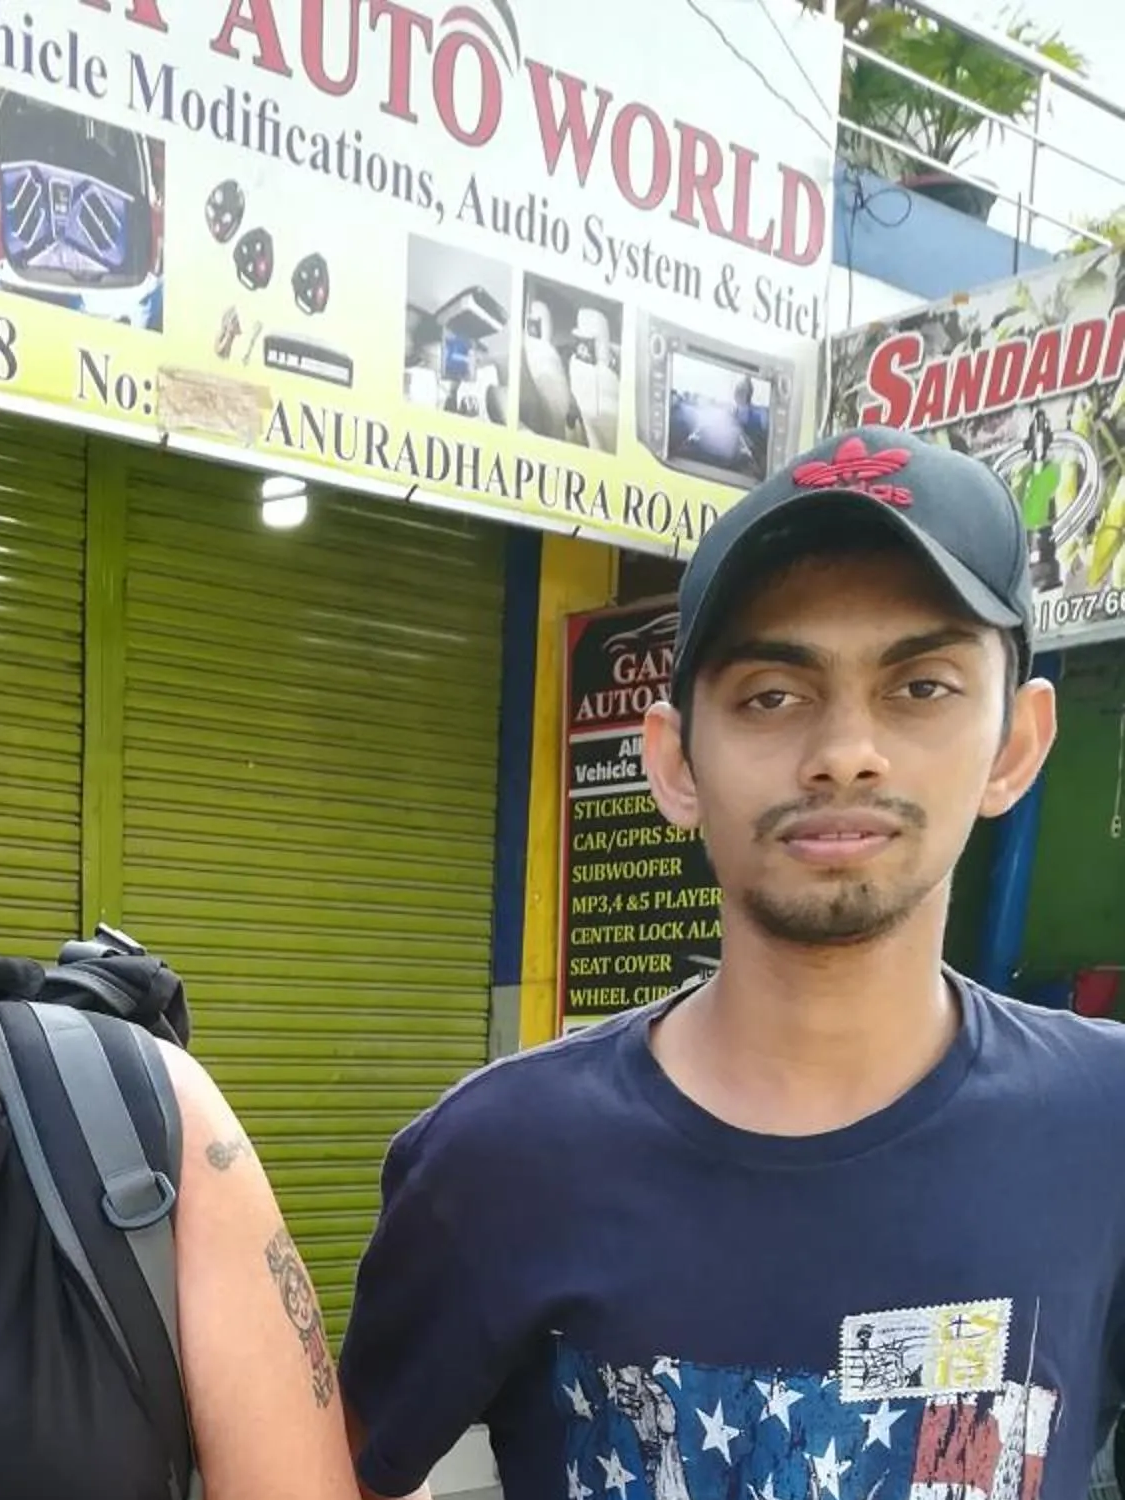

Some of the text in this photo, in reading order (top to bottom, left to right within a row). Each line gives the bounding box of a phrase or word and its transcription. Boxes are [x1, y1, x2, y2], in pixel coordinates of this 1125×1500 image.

[209, 0, 826, 267] AUTO WORLD
[127, 51, 445, 224] Modifications,
[456, 173, 570, 254] Audio
[582, 214, 702, 300] System
[714, 263, 741, 314] &
[78, 348, 153, 416] No:
[265, 399, 610, 520] ANURADHAPURA
[622, 484, 719, 541] ROAD
[576, 685, 653, 721] AUTO
[576, 759, 637, 783] Vehicle
[574, 795, 656, 820] STICKERS
[573, 826, 662, 853] CAR/GPRS
[572, 857, 683, 883] SUBWOOFER
[572, 893, 623, 915] MP3,4
[654, 887, 723, 909] PLAYER
[570, 925, 636, 945] CENTER
[639, 920, 684, 941] LOCK
[570, 954, 672, 976] SEAT COVER
[570, 987, 630, 1007] WHEEL
